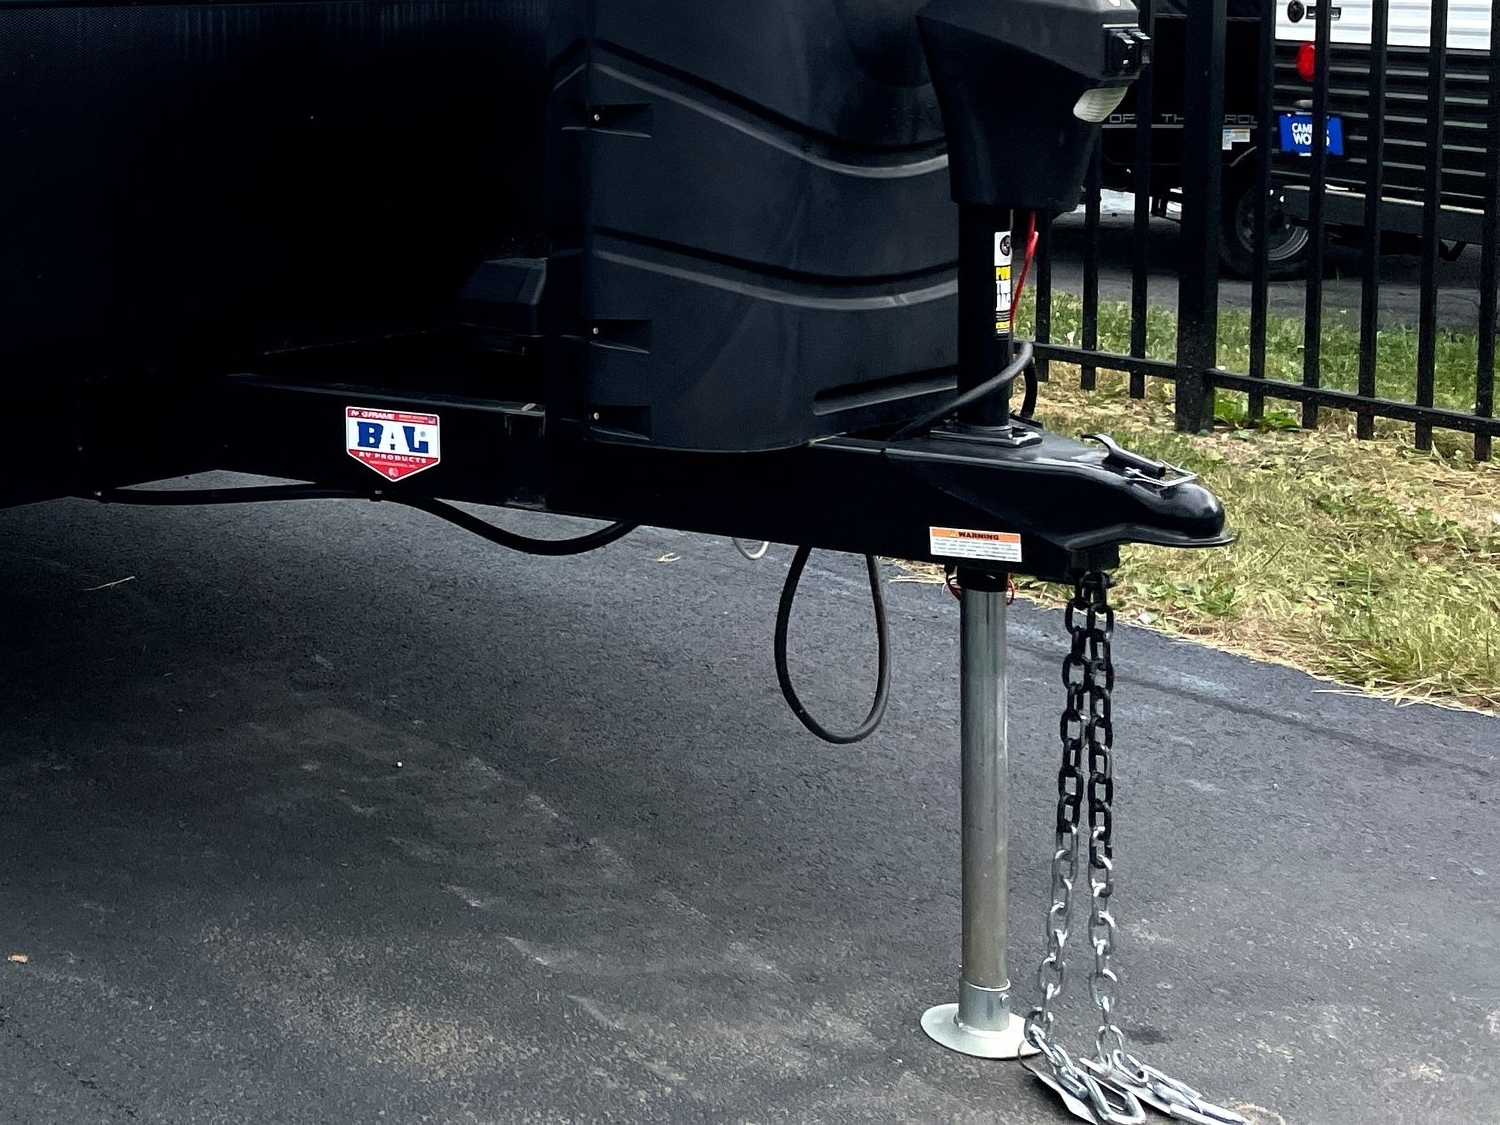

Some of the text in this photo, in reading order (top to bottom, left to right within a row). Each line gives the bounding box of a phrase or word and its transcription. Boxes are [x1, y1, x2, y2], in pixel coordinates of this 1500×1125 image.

[356, 421, 429, 453] BAL
[375, 453, 427, 464] PRODUCTS
[958, 531, 1000, 541] WARNING
